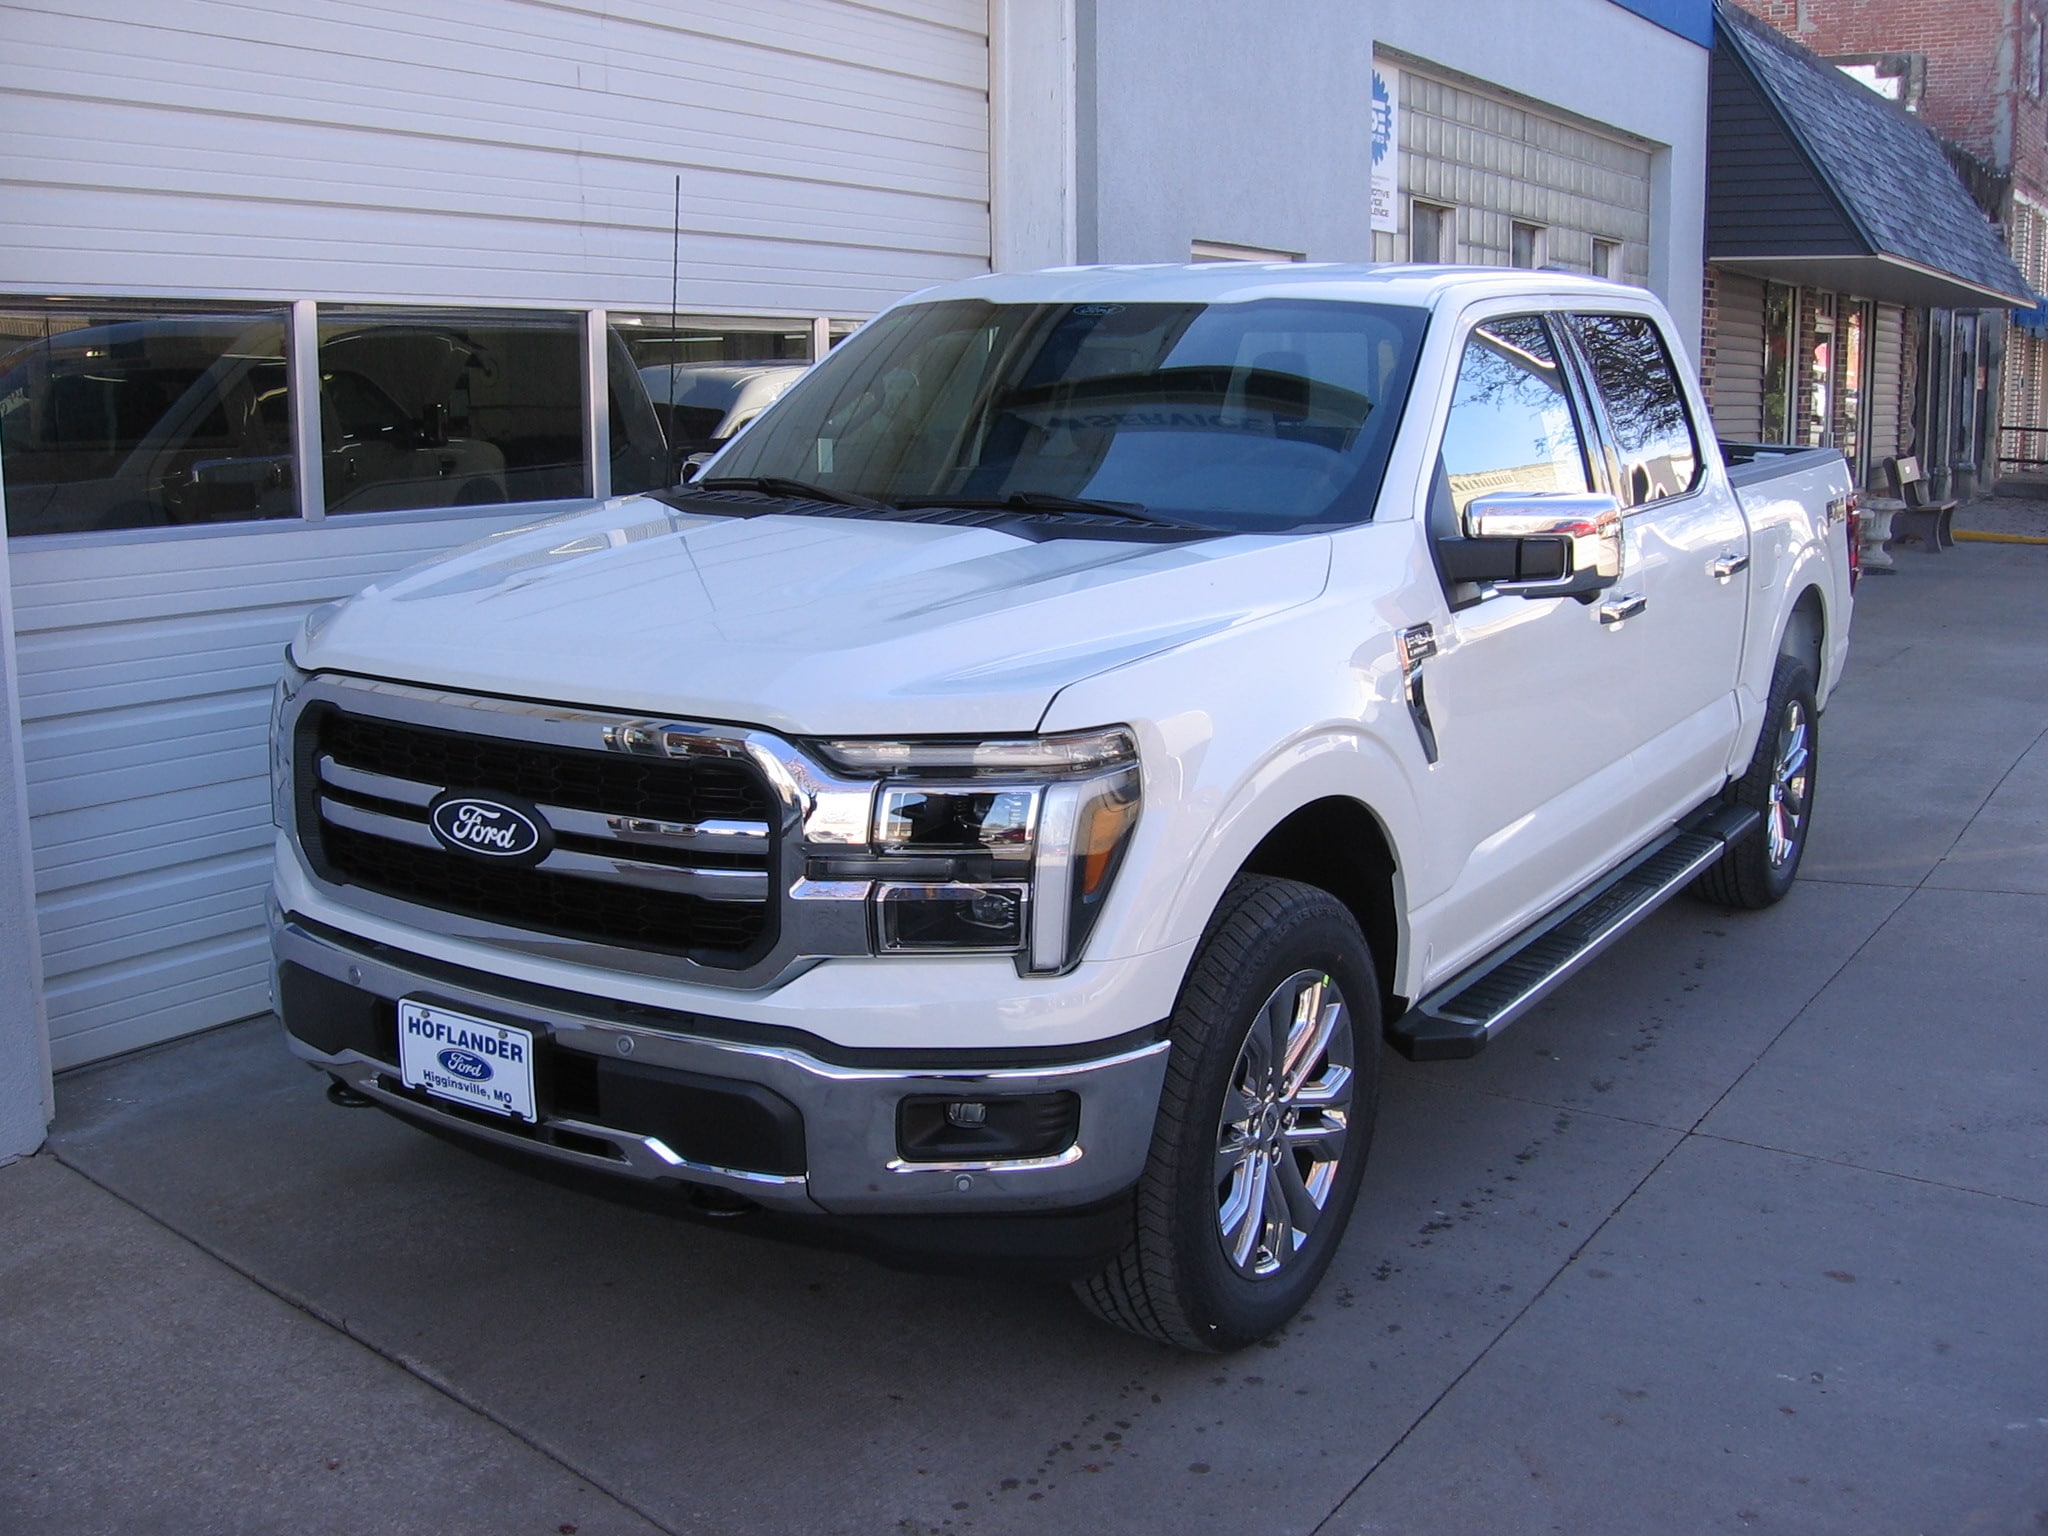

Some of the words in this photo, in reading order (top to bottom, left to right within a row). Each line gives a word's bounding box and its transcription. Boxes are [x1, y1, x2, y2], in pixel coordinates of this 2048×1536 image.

[453, 805, 517, 849] Ford
[408, 1016, 523, 1063] HOFLANDER
[447, 1052, 482, 1077] Ford
[423, 1069, 490, 1100] Higginsville,
[494, 1089, 512, 1104] MO
